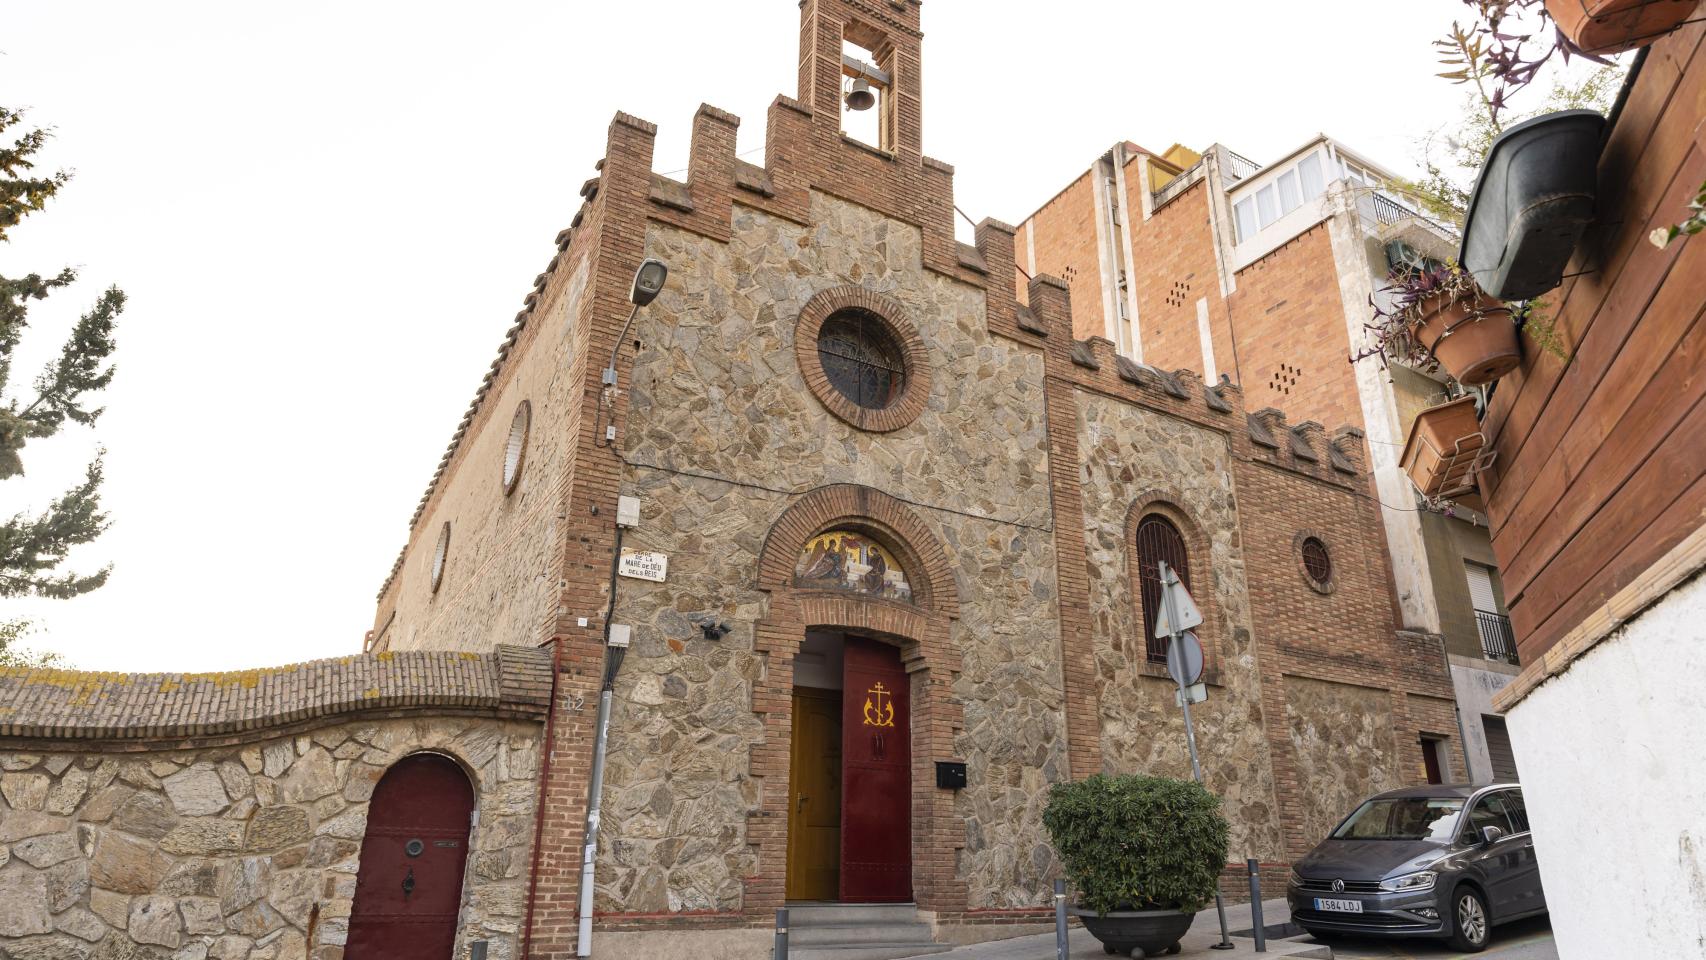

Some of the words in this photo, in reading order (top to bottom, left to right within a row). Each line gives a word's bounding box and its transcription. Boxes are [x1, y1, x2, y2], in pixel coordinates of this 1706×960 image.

[625, 559, 641, 567] MARE
[644, 570, 657, 578] REIS
[1321, 899, 1341, 909] 1584
[1343, 901, 1360, 911] LDJ
